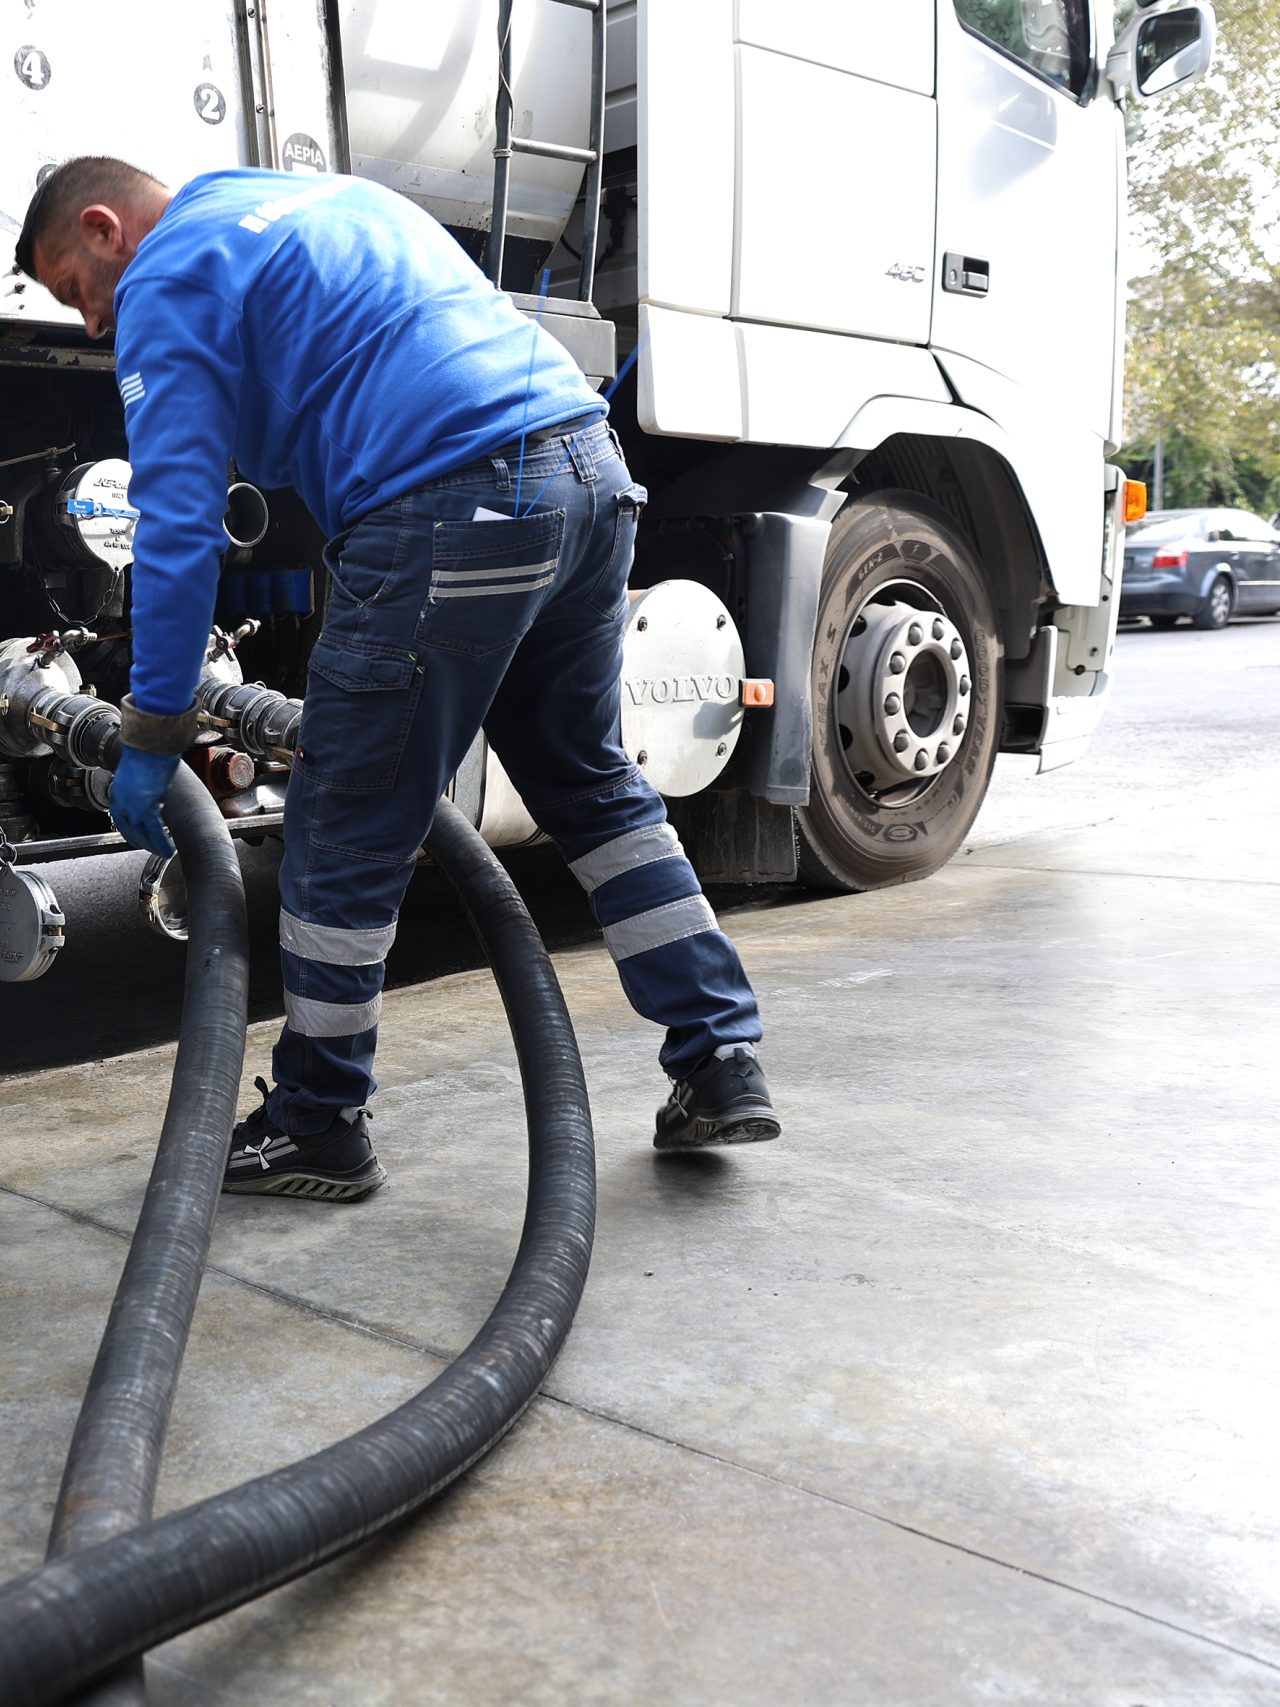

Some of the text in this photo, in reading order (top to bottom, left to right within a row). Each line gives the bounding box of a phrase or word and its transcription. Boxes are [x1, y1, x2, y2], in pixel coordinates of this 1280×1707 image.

[22, 50, 46, 85] 4
[200, 88, 221, 121] 2
[625, 674, 738, 706] VOLVO
